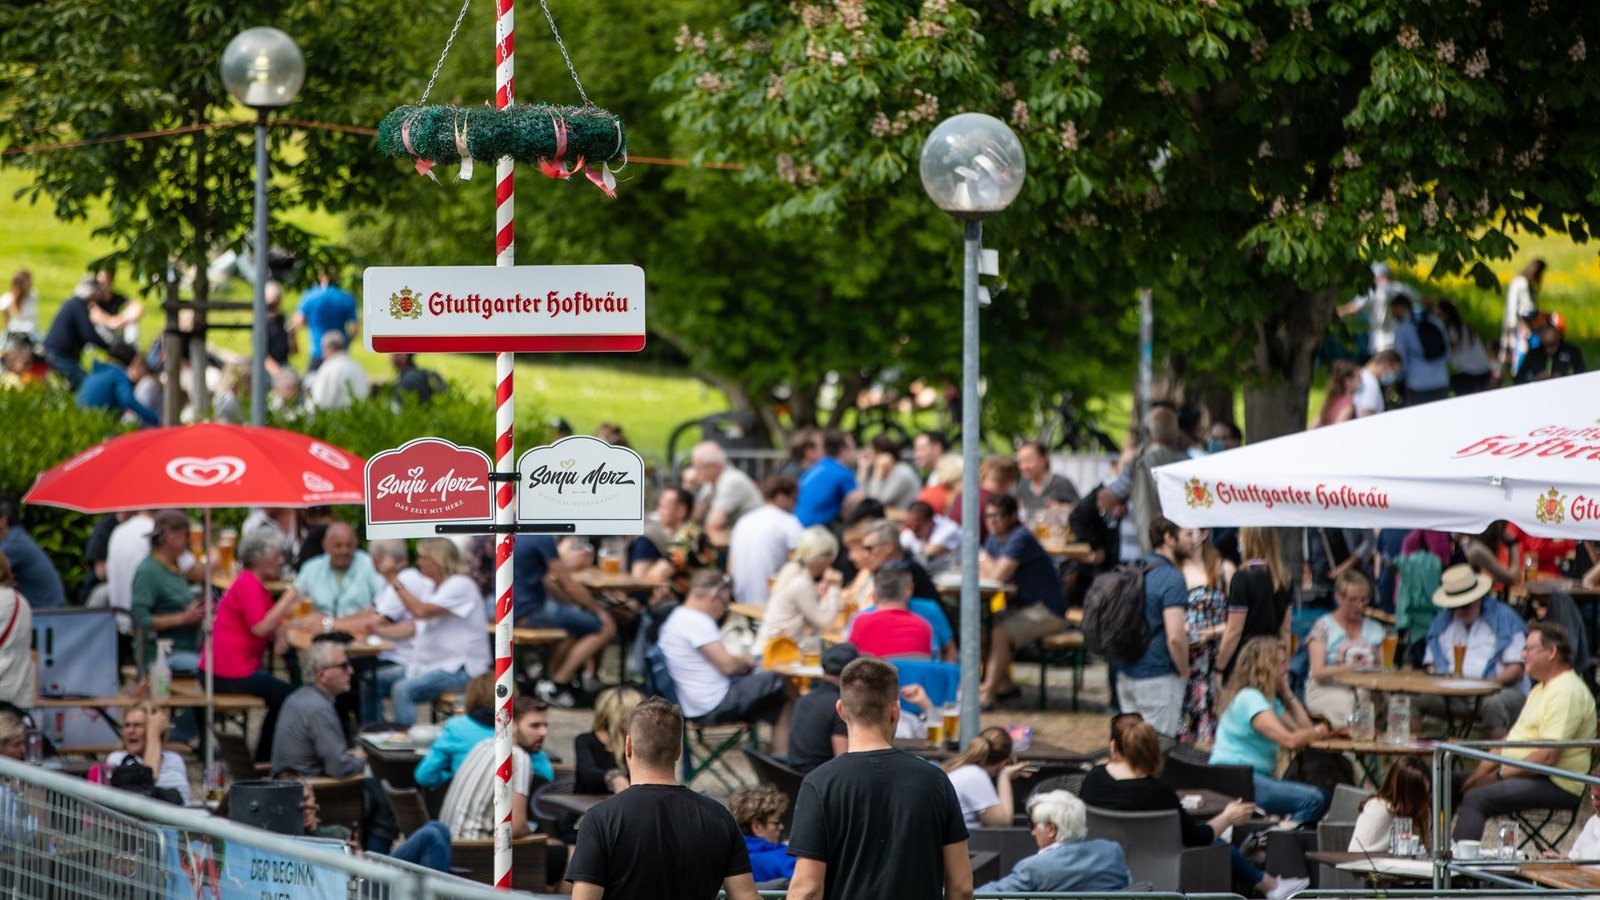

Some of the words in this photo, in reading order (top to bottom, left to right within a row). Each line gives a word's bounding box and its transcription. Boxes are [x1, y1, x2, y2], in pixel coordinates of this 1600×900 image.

[428, 291, 541, 320] Stuttgarter
[546, 290, 629, 318] Hofbräu
[376, 466, 429, 503] Sonja
[430, 468, 486, 502] Merz
[529, 461, 579, 494] Sonja
[581, 462, 636, 494] Merz
[394, 501, 409, 512] DAS
[410, 506, 427, 515] ZELT
[429, 506, 443, 515] MIT
[445, 499, 464, 512] HERZ
[1216, 481, 1312, 509] Stuttgarter
[1315, 483, 1389, 510] Hofbräu
[250, 858, 270, 882] DER
[272, 860, 316, 887] BEGINN
